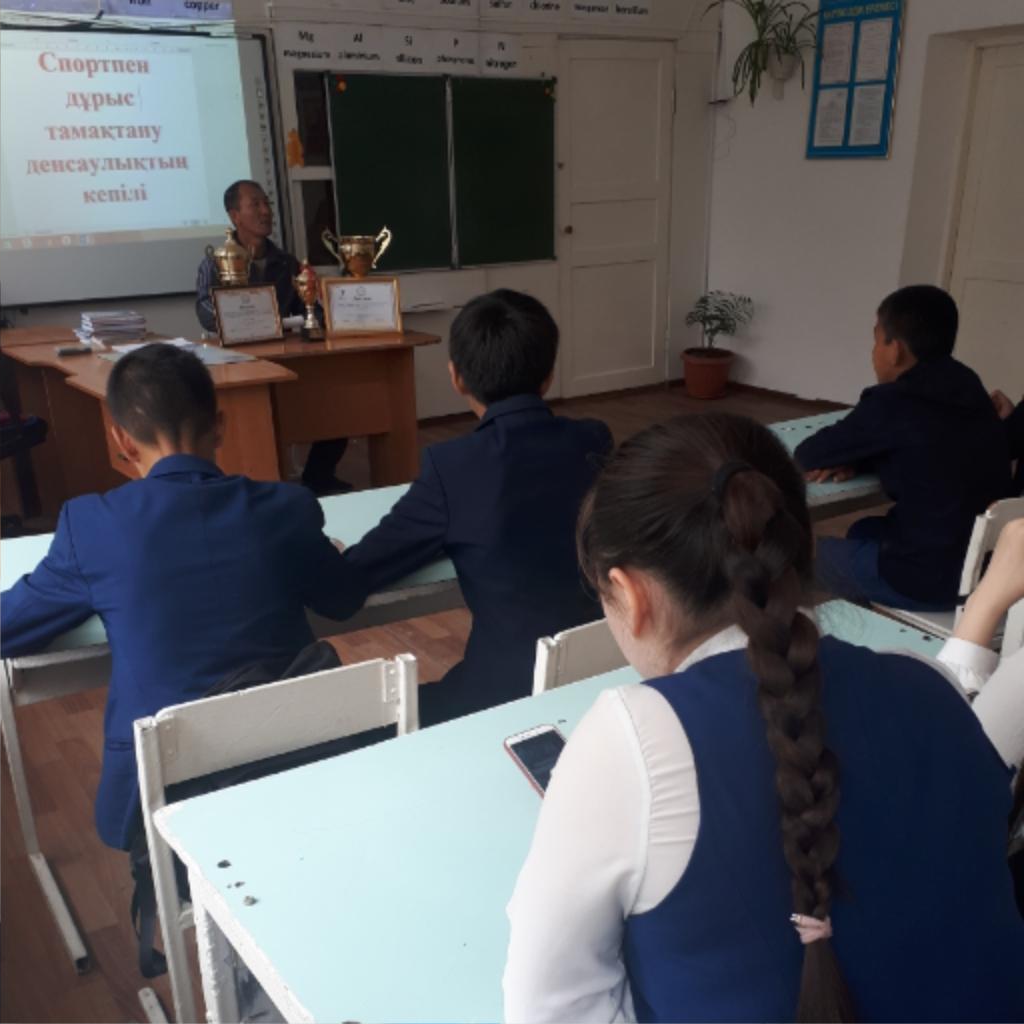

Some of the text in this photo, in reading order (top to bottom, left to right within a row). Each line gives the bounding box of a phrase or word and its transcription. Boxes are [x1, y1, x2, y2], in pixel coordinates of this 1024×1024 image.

[38, 51, 150, 78] Спортпен
[65, 91, 135, 112] дұрыс
[44, 125, 162, 144] тамақтану
[82, 183, 148, 204] кепілі
